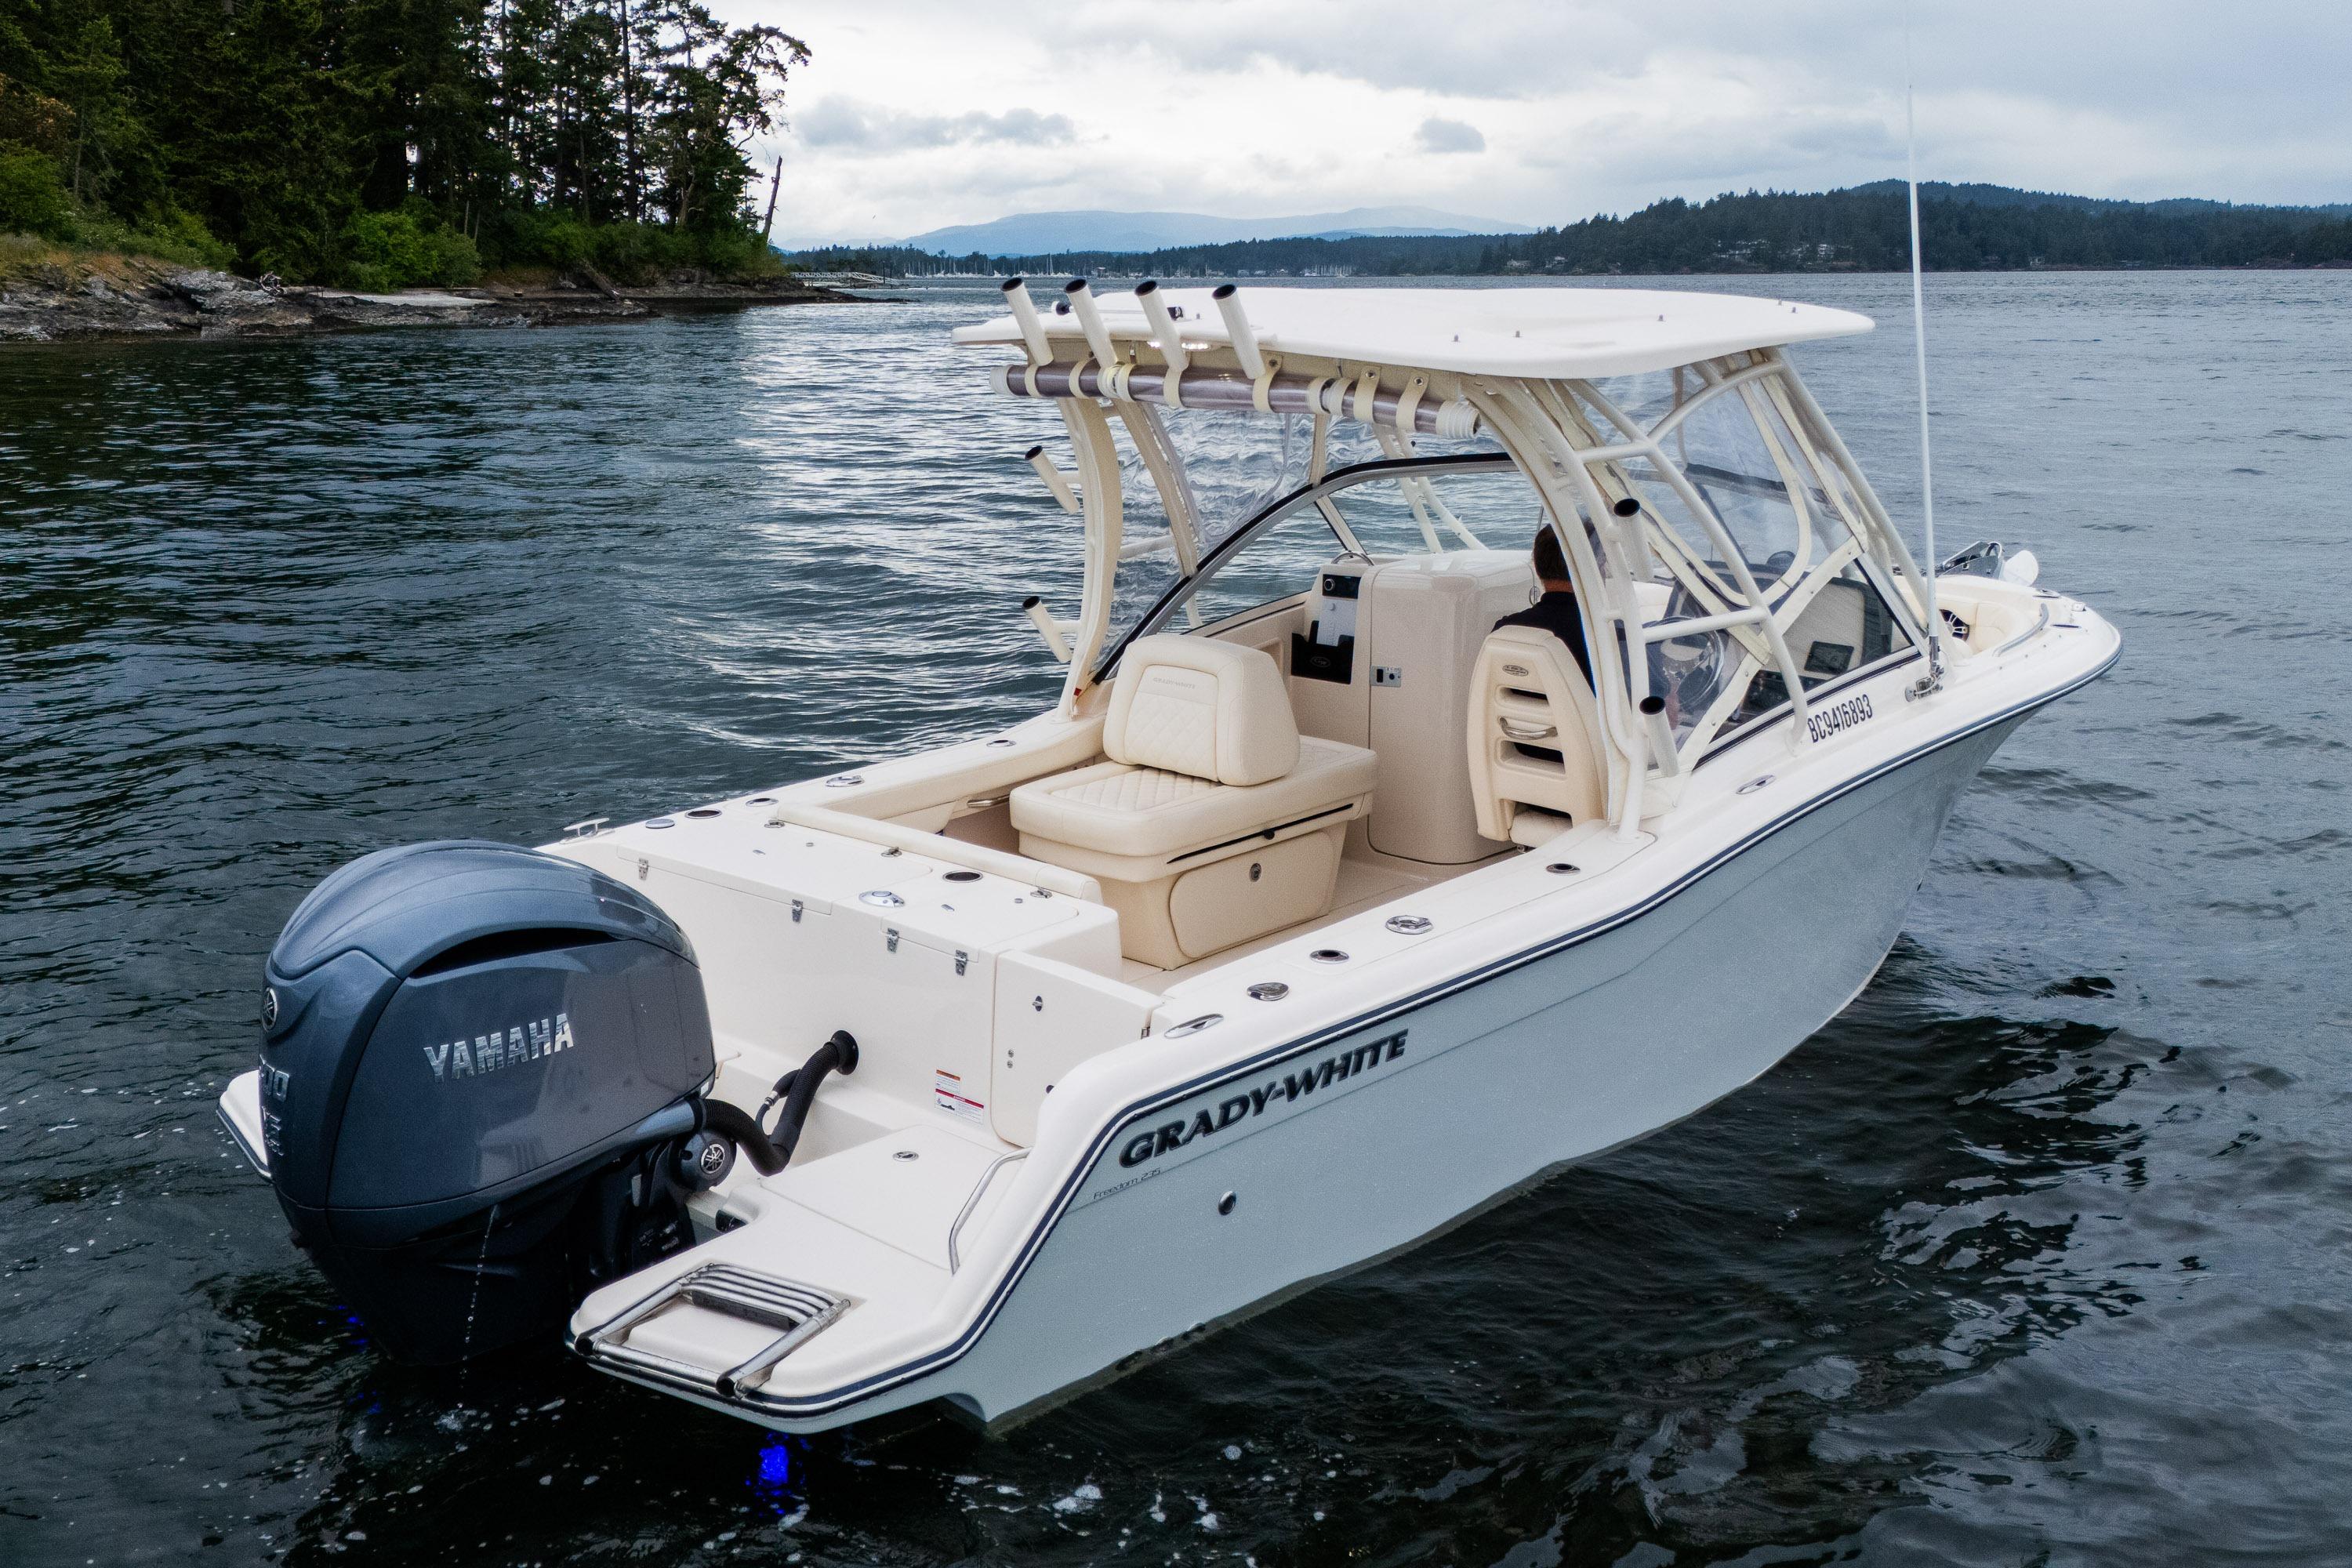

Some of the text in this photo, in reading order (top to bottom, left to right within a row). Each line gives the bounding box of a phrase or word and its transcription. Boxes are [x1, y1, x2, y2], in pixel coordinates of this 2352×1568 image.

[1807, 694, 1873, 743] BC9416893
[423, 1013, 574, 1083] YAMAHA
[260, 1054, 290, 1102] 00
[1119, 1029, 1409, 1168] GRADY-WHITE
[1093, 1167, 1161, 1200] Freedom 235
